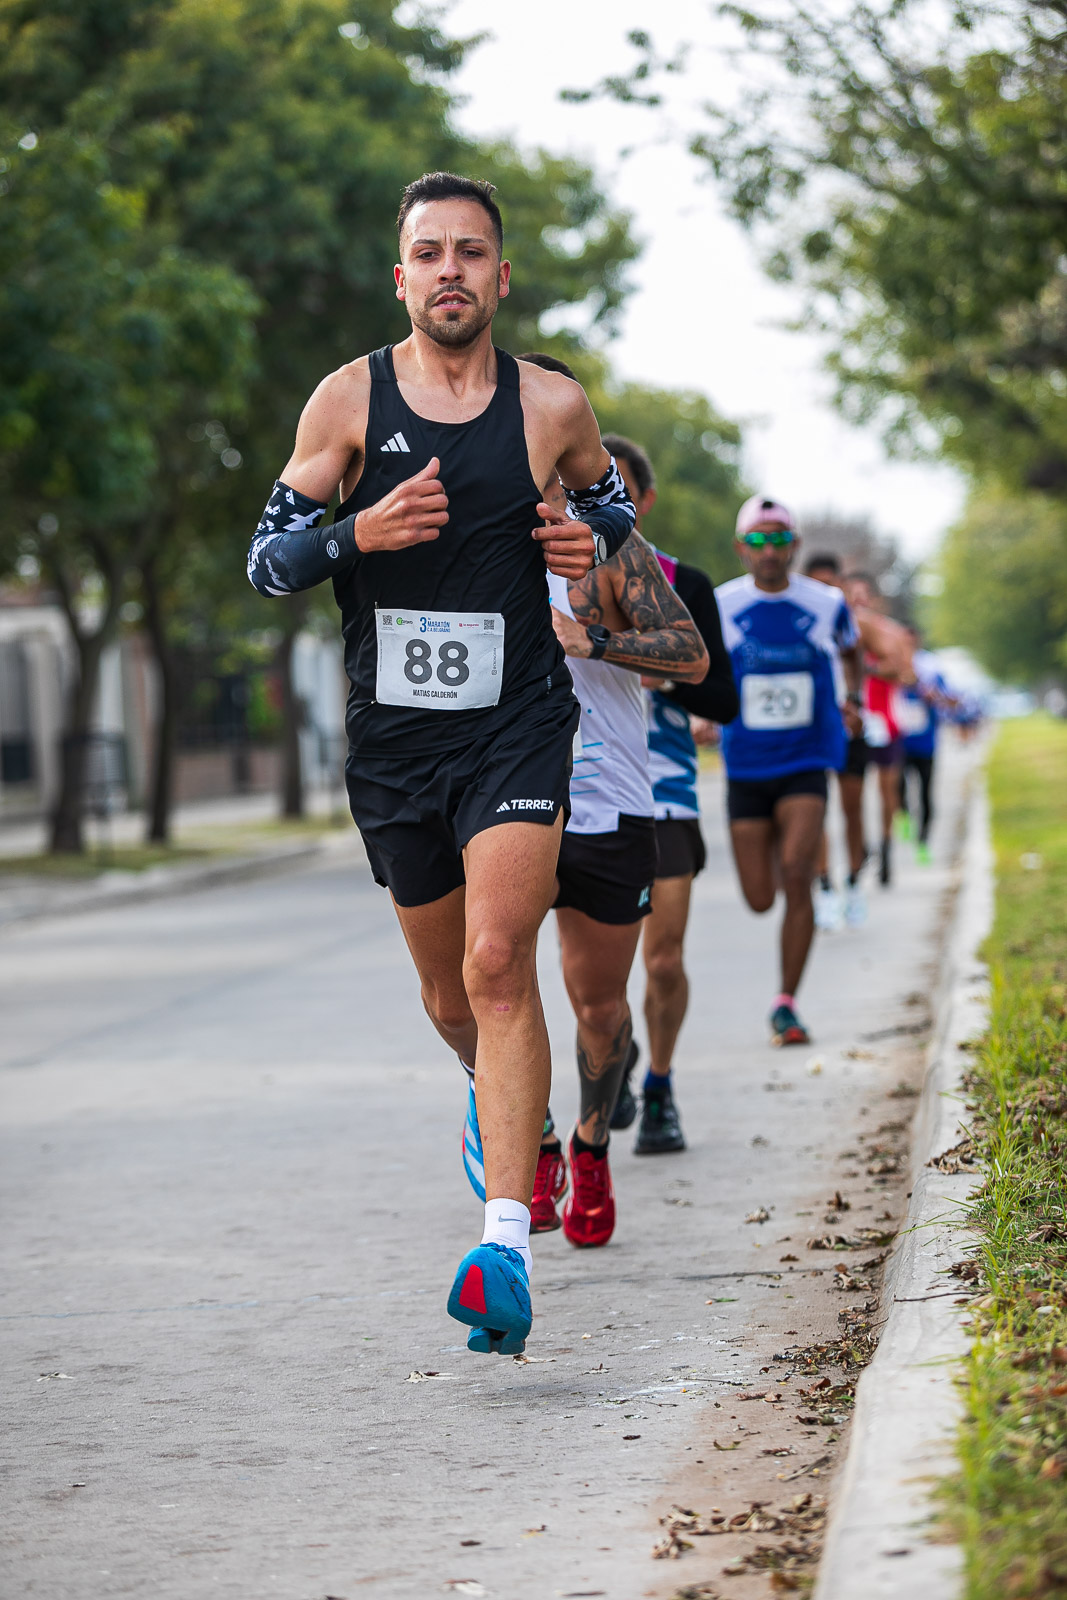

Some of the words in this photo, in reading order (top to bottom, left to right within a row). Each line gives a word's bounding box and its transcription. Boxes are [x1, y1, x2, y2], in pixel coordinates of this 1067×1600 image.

[420, 617, 427, 632] 3
[404, 638, 470, 686] 88
[413, 689, 430, 698] MATIAS
[431, 690, 458, 699] CALDERÓN
[510, 799, 554, 811] TERREX
